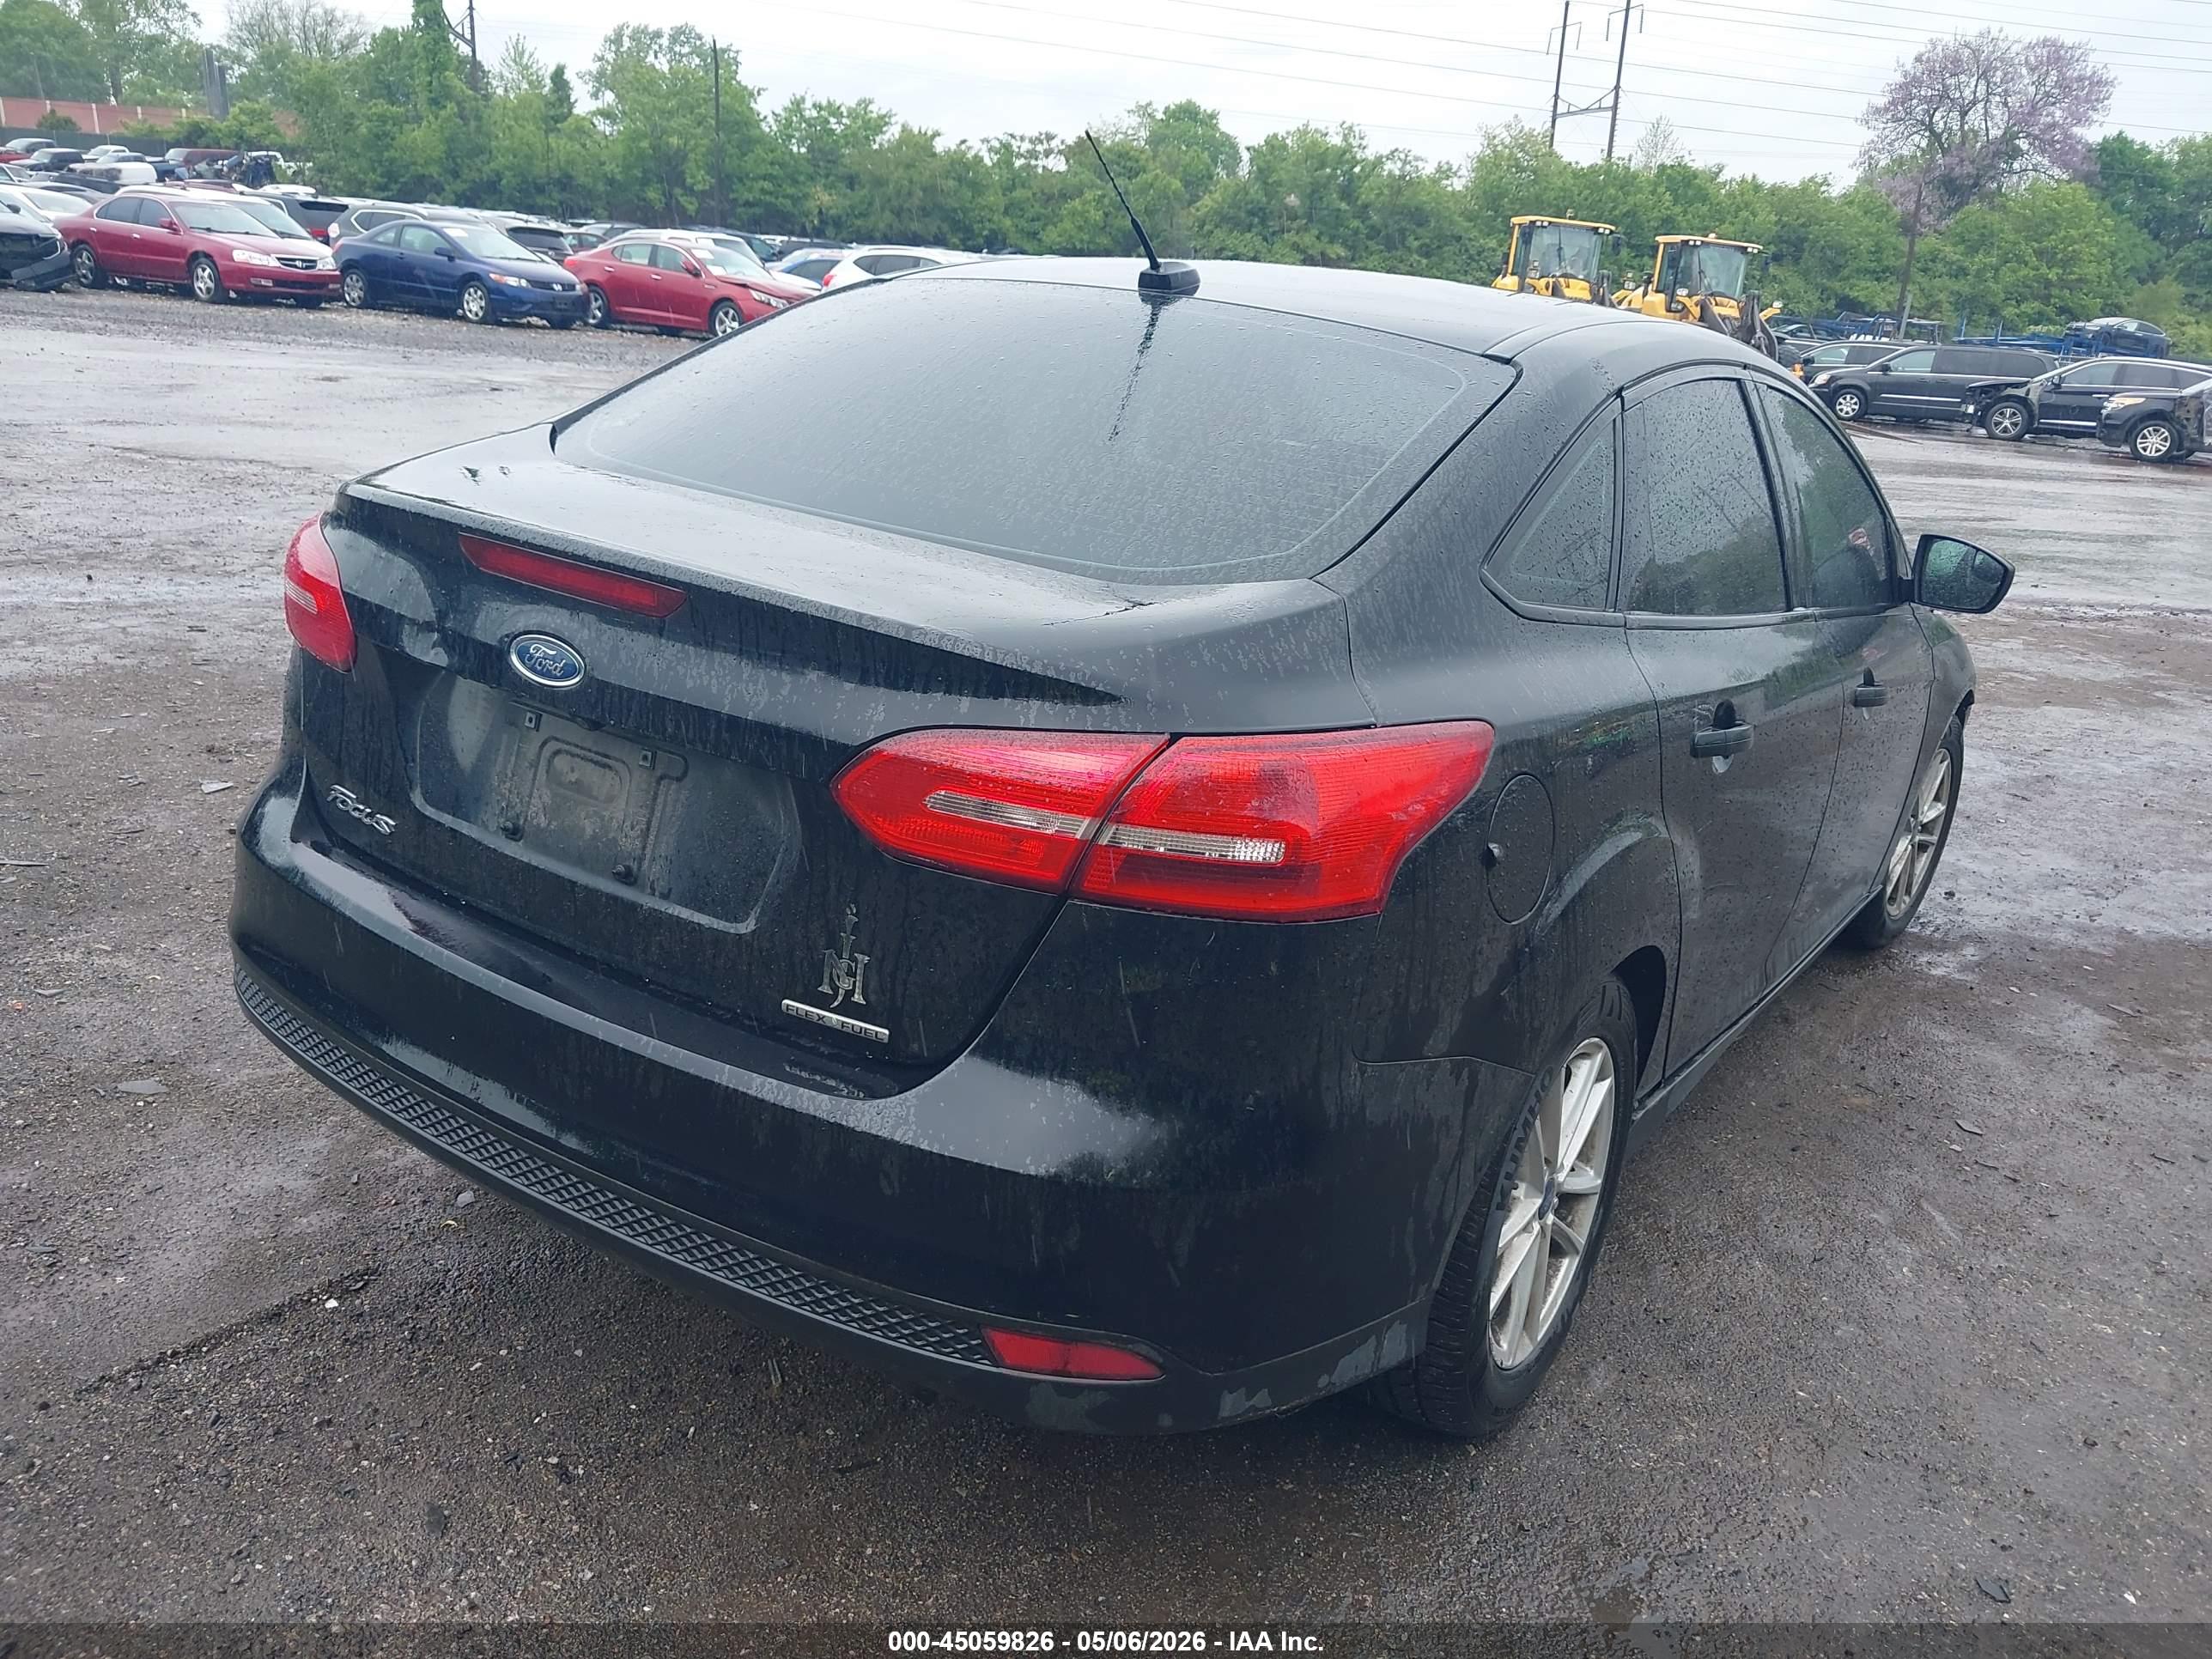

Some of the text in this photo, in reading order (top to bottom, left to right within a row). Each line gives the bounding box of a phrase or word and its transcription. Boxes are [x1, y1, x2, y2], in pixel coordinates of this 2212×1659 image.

[524, 643, 567, 677] Ford
[786, 1004, 885, 1042] FLEX FUEL
